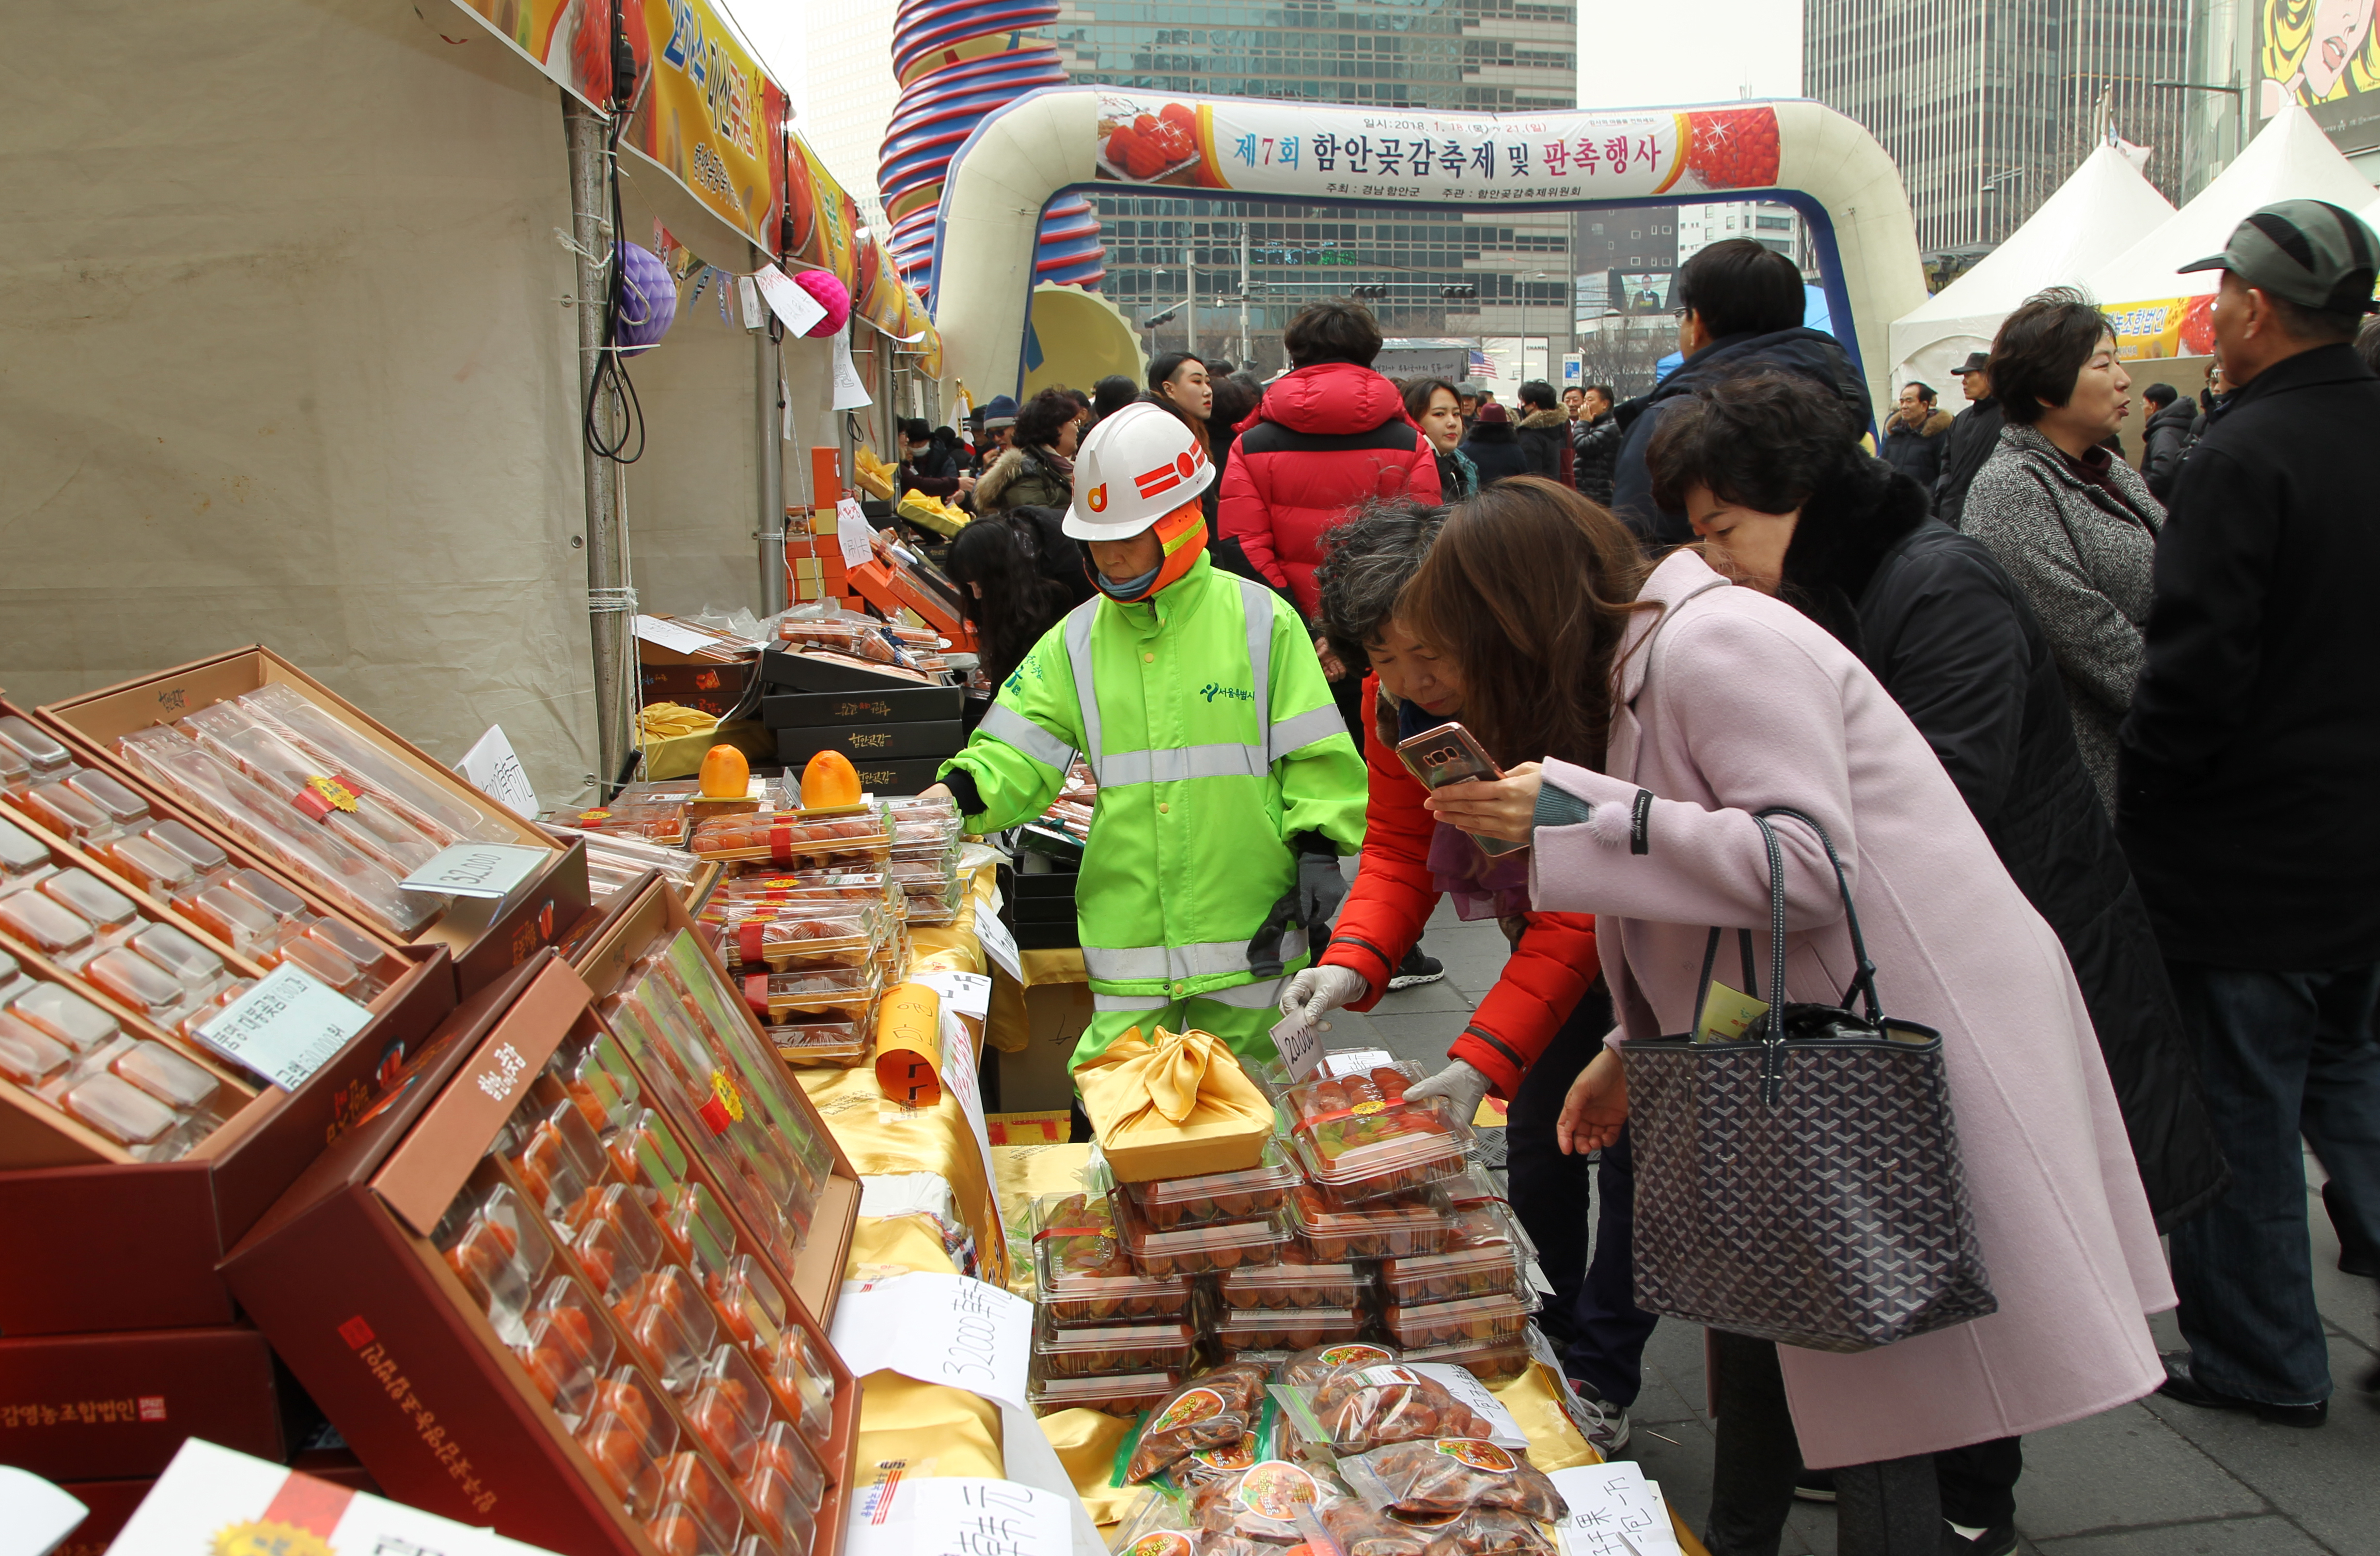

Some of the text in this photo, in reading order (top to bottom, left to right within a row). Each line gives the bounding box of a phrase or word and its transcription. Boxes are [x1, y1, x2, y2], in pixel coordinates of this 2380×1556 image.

[707, 38, 757, 161] 미산곶감
[1233, 133, 1662, 180] 제7회 함안곶감축제 및 판촉행사
[1326, 183, 1349, 194] 주최
[1442, 188, 1464, 199] 주관
[1478, 186, 1581, 199] 함안곶감축제위원회
[1218, 688, 1255, 702] 서울특별시
[849, 733, 891, 749] 함안곶감
[1637, 796, 1647, 819] CASHMERE
[361, 1342, 499, 1516] 함주곶감영농조합법인
